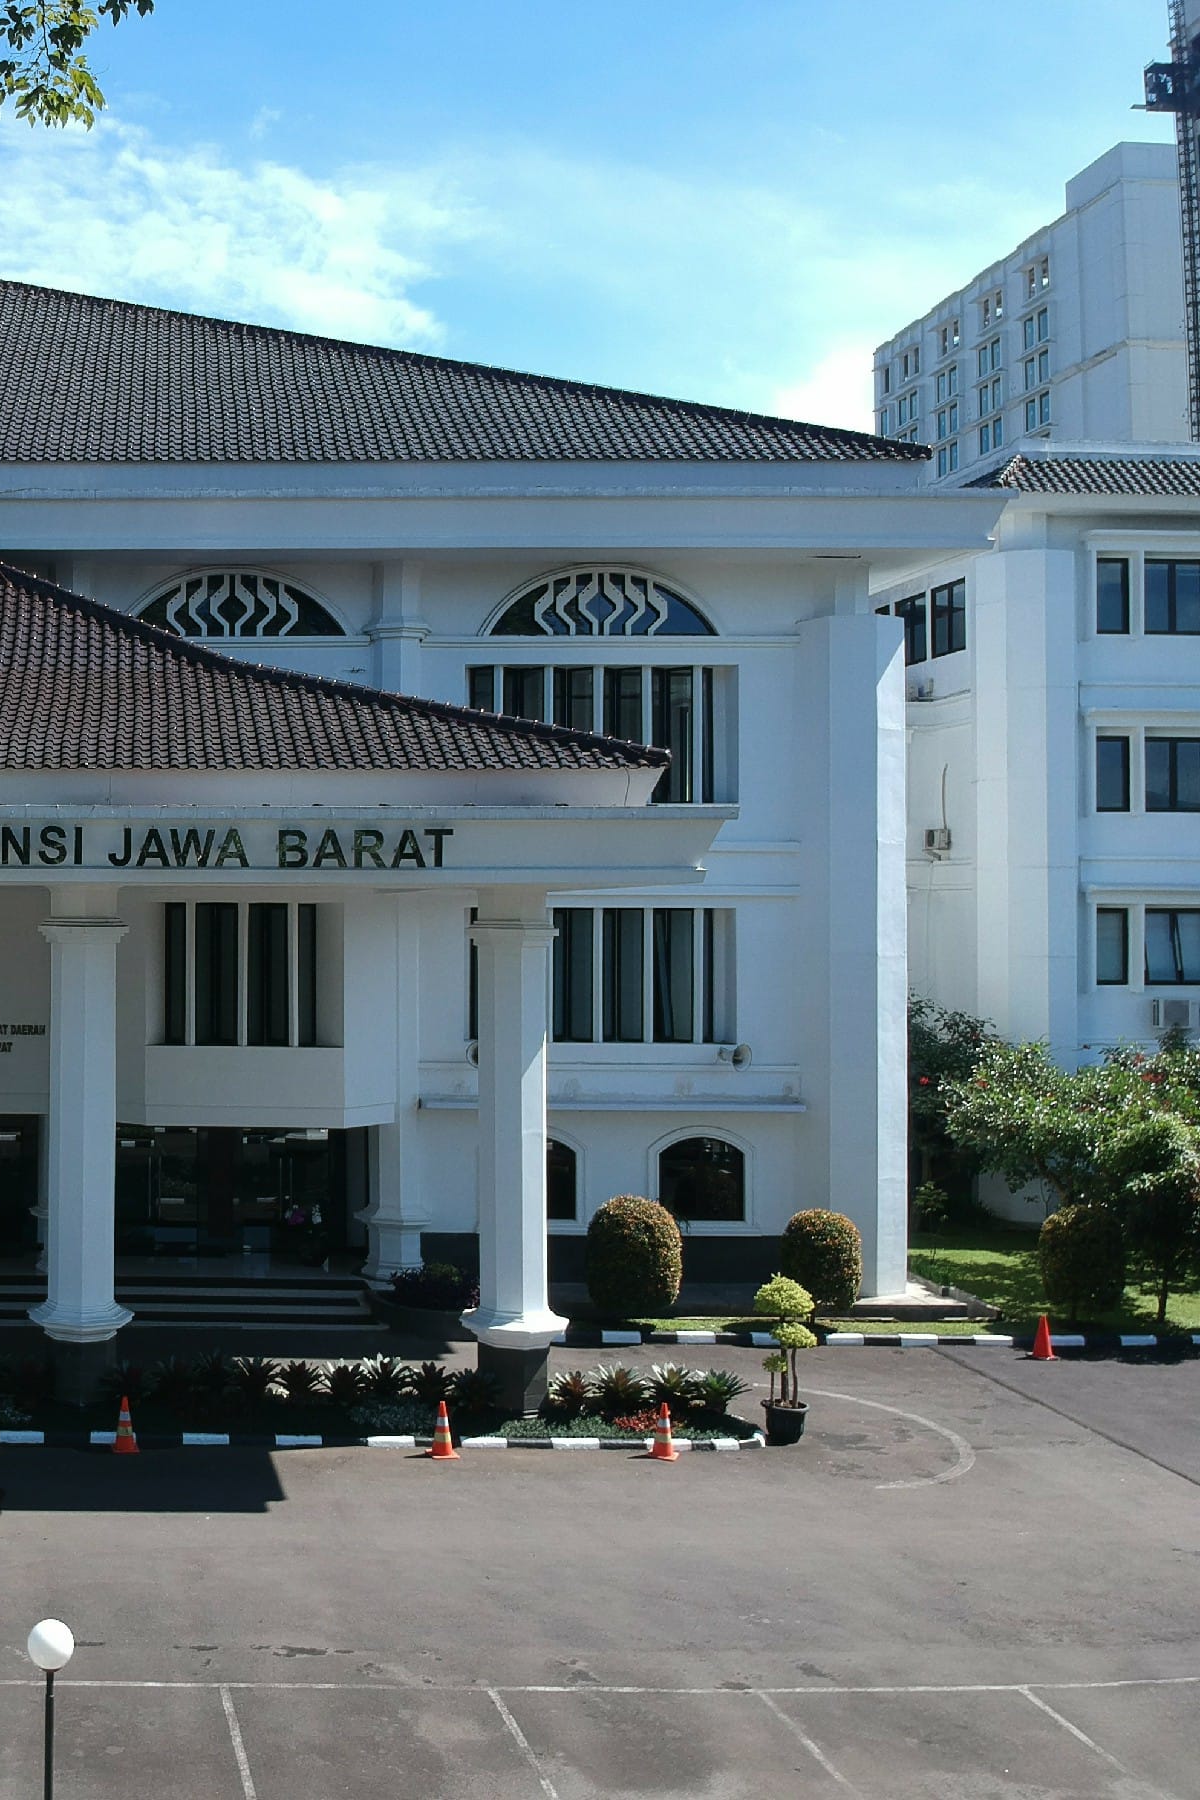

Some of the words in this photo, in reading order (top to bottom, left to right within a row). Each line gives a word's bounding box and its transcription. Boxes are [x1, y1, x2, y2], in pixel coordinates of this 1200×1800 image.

[107, 826, 250, 868] JAWA
[278, 827, 455, 869] BARAT
[10, 1024, 46, 1035] DAERAH
